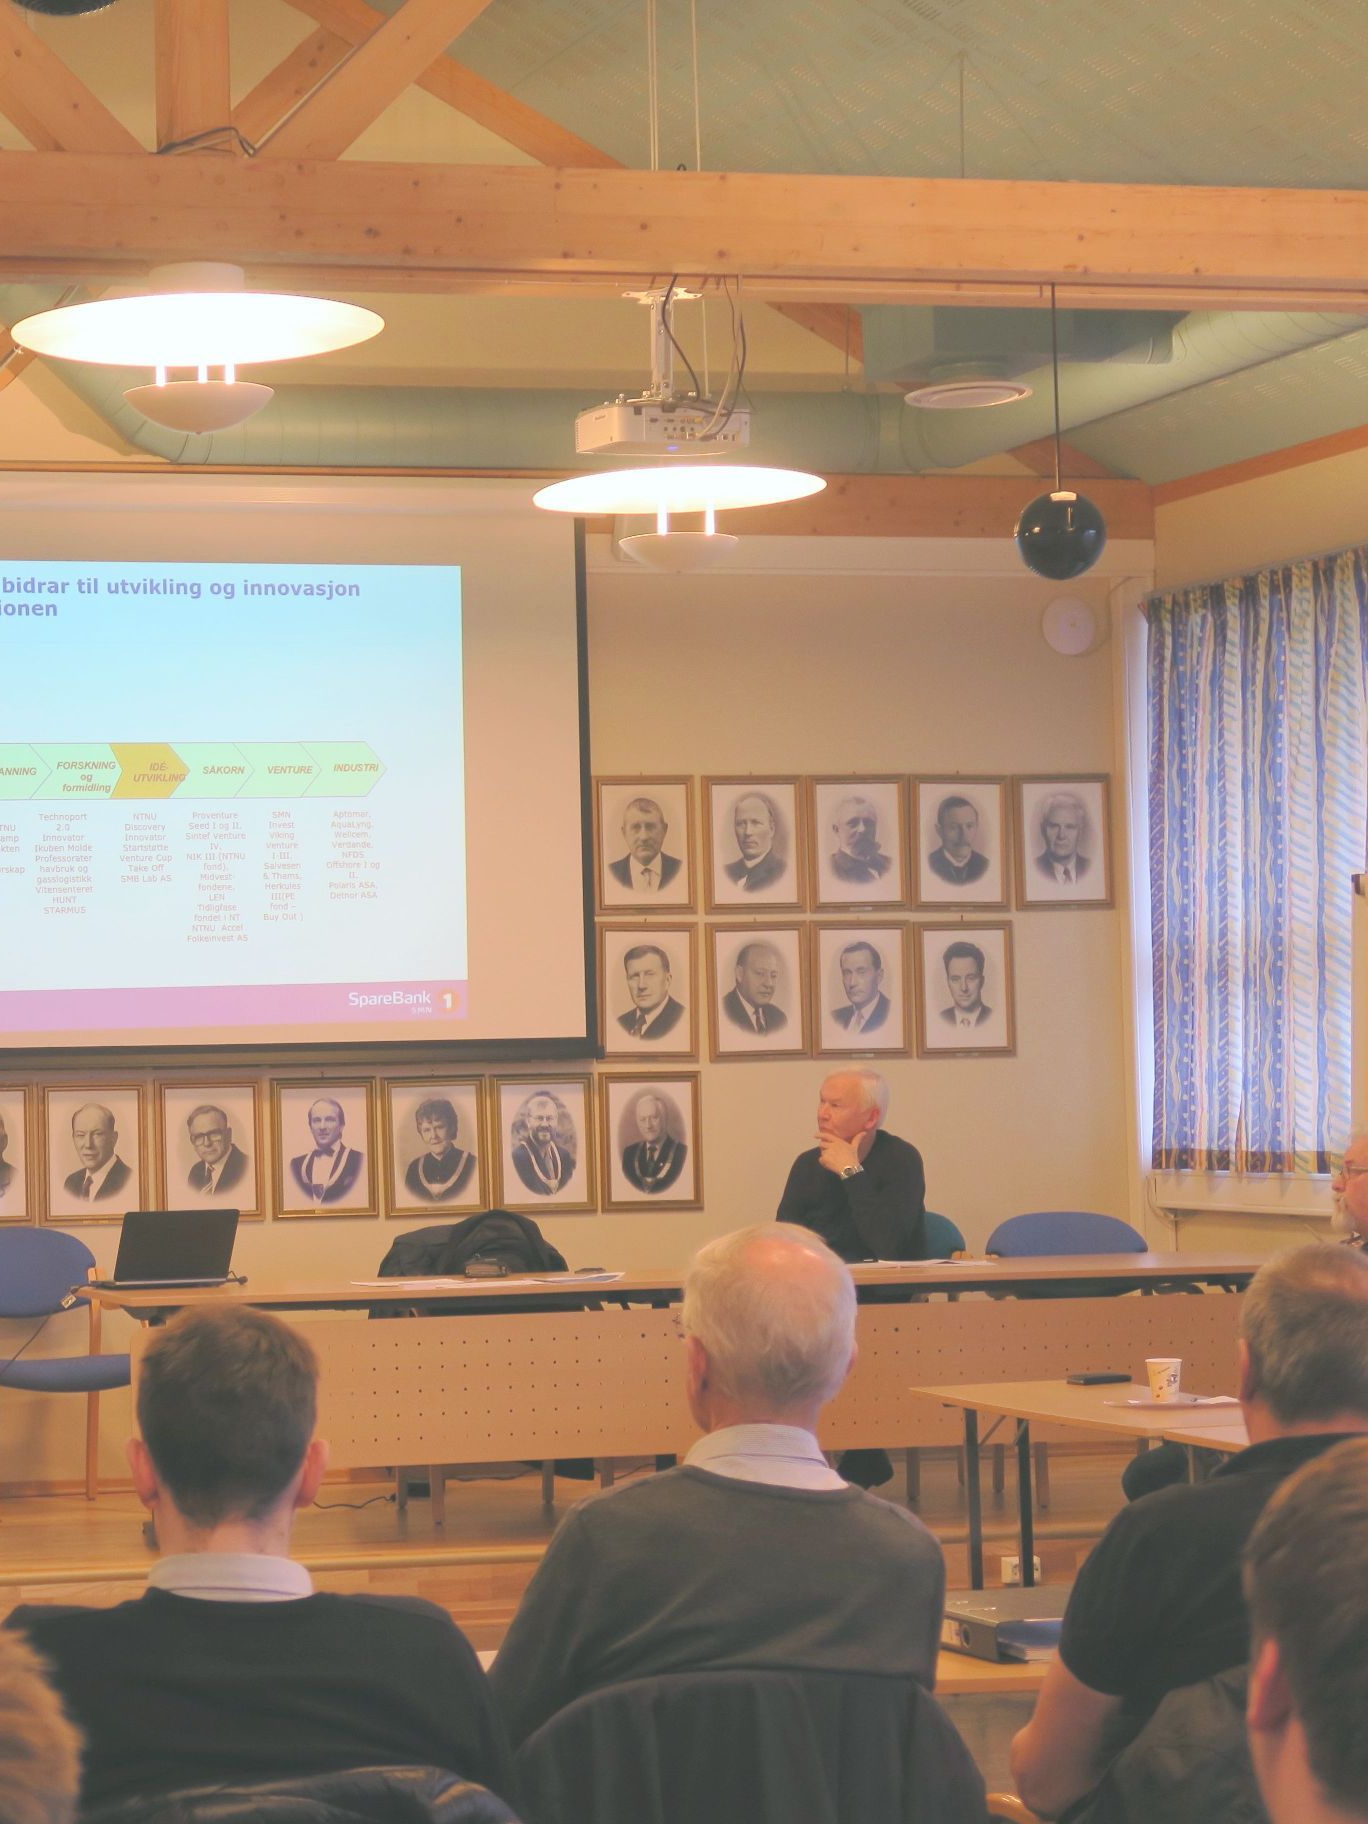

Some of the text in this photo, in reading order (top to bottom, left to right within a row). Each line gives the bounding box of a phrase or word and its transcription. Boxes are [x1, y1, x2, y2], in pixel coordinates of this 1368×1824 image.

[2, 577, 70, 594] bidrar
[76, 578, 99, 594] til
[106, 578, 202, 599] utvikling
[209, 582, 235, 599] og
[243, 580, 361, 600] innovasjon
[56, 761, 116, 770] FORSKNING
[202, 765, 245, 774] SÅKORN
[333, 763, 379, 772] INDUSTRI
[267, 766, 313, 774] VENTURE
[80, 774, 93, 782] og
[133, 773, 186, 782] UTVIKLING
[62, 784, 111, 793] formidling
[39, 812, 88, 822] Technoport
[133, 812, 157, 821] NTNU
[192, 811, 238, 820] Proventure
[272, 811, 291, 819] SMN
[56, 823, 70, 832] 2.0
[124, 824, 166, 832] Discovery
[188, 822, 210, 830] Seed
[269, 821, 296, 829] Invest
[42, 834, 84, 842] Innovator
[125, 834, 167, 842] Innovator
[185, 832, 210, 840] Sintef
[269, 832, 295, 841] Viking
[68, 844, 93, 852] Molde
[266, 842, 299, 850] Venture
[35, 854, 93, 862] Professorater
[120, 854, 173, 863] Venture Cup
[39, 865, 89, 874] havbruk og
[128, 864, 165, 872] Take Off
[264, 862, 302, 870] Salvesen
[36, 874, 92, 885] gasslogistikk
[160, 874, 173, 882] AS
[34, 886, 94, 894] Vitensenteret
[264, 882, 301, 890] Herkules
[43, 906, 88, 914] STARMUS
[264, 913, 279, 922] Buy
[237, 934, 249, 942] AS
[348, 990, 452, 1008] SpareBank 1
